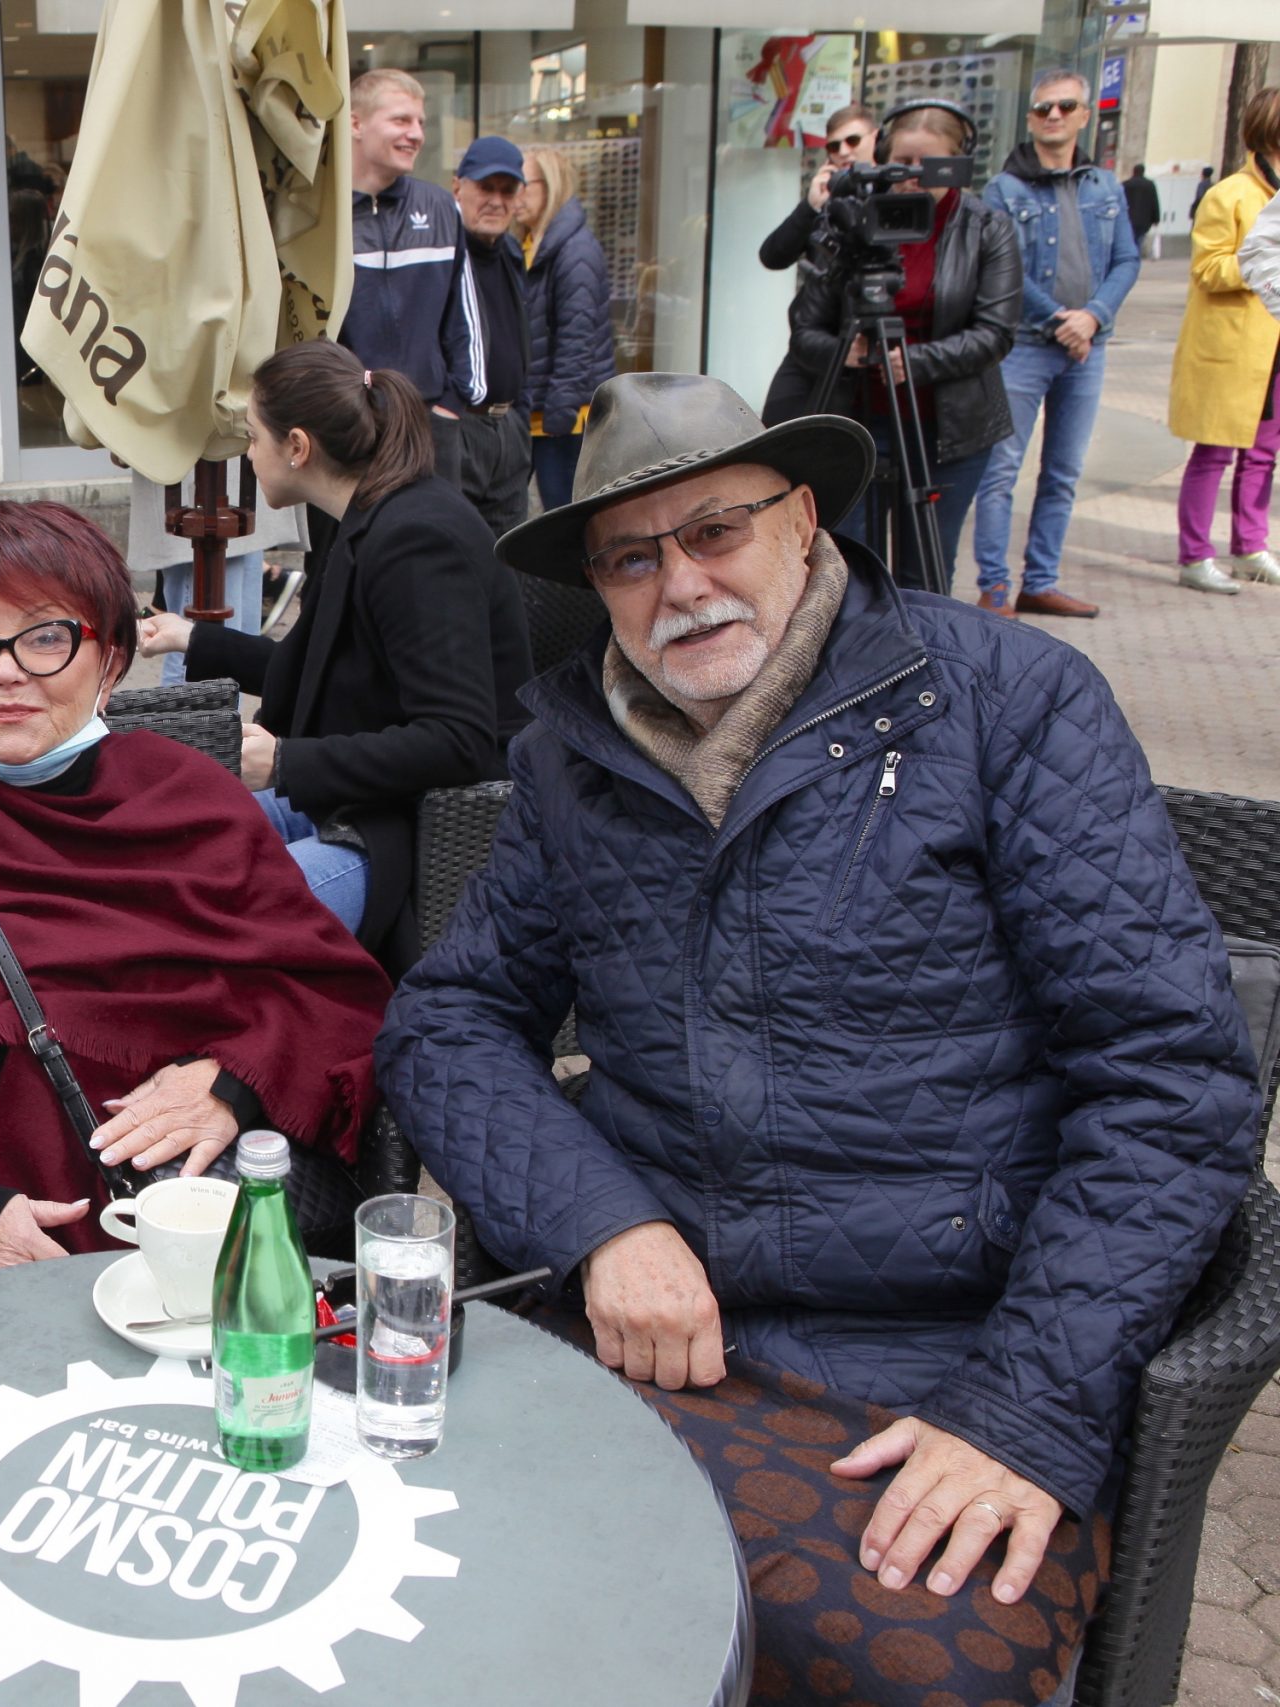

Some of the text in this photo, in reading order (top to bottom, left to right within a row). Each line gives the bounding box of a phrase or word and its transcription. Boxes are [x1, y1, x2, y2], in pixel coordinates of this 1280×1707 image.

[89, 1417, 208, 1452] wine bar
[37, 1431, 327, 1544] POLITAN
